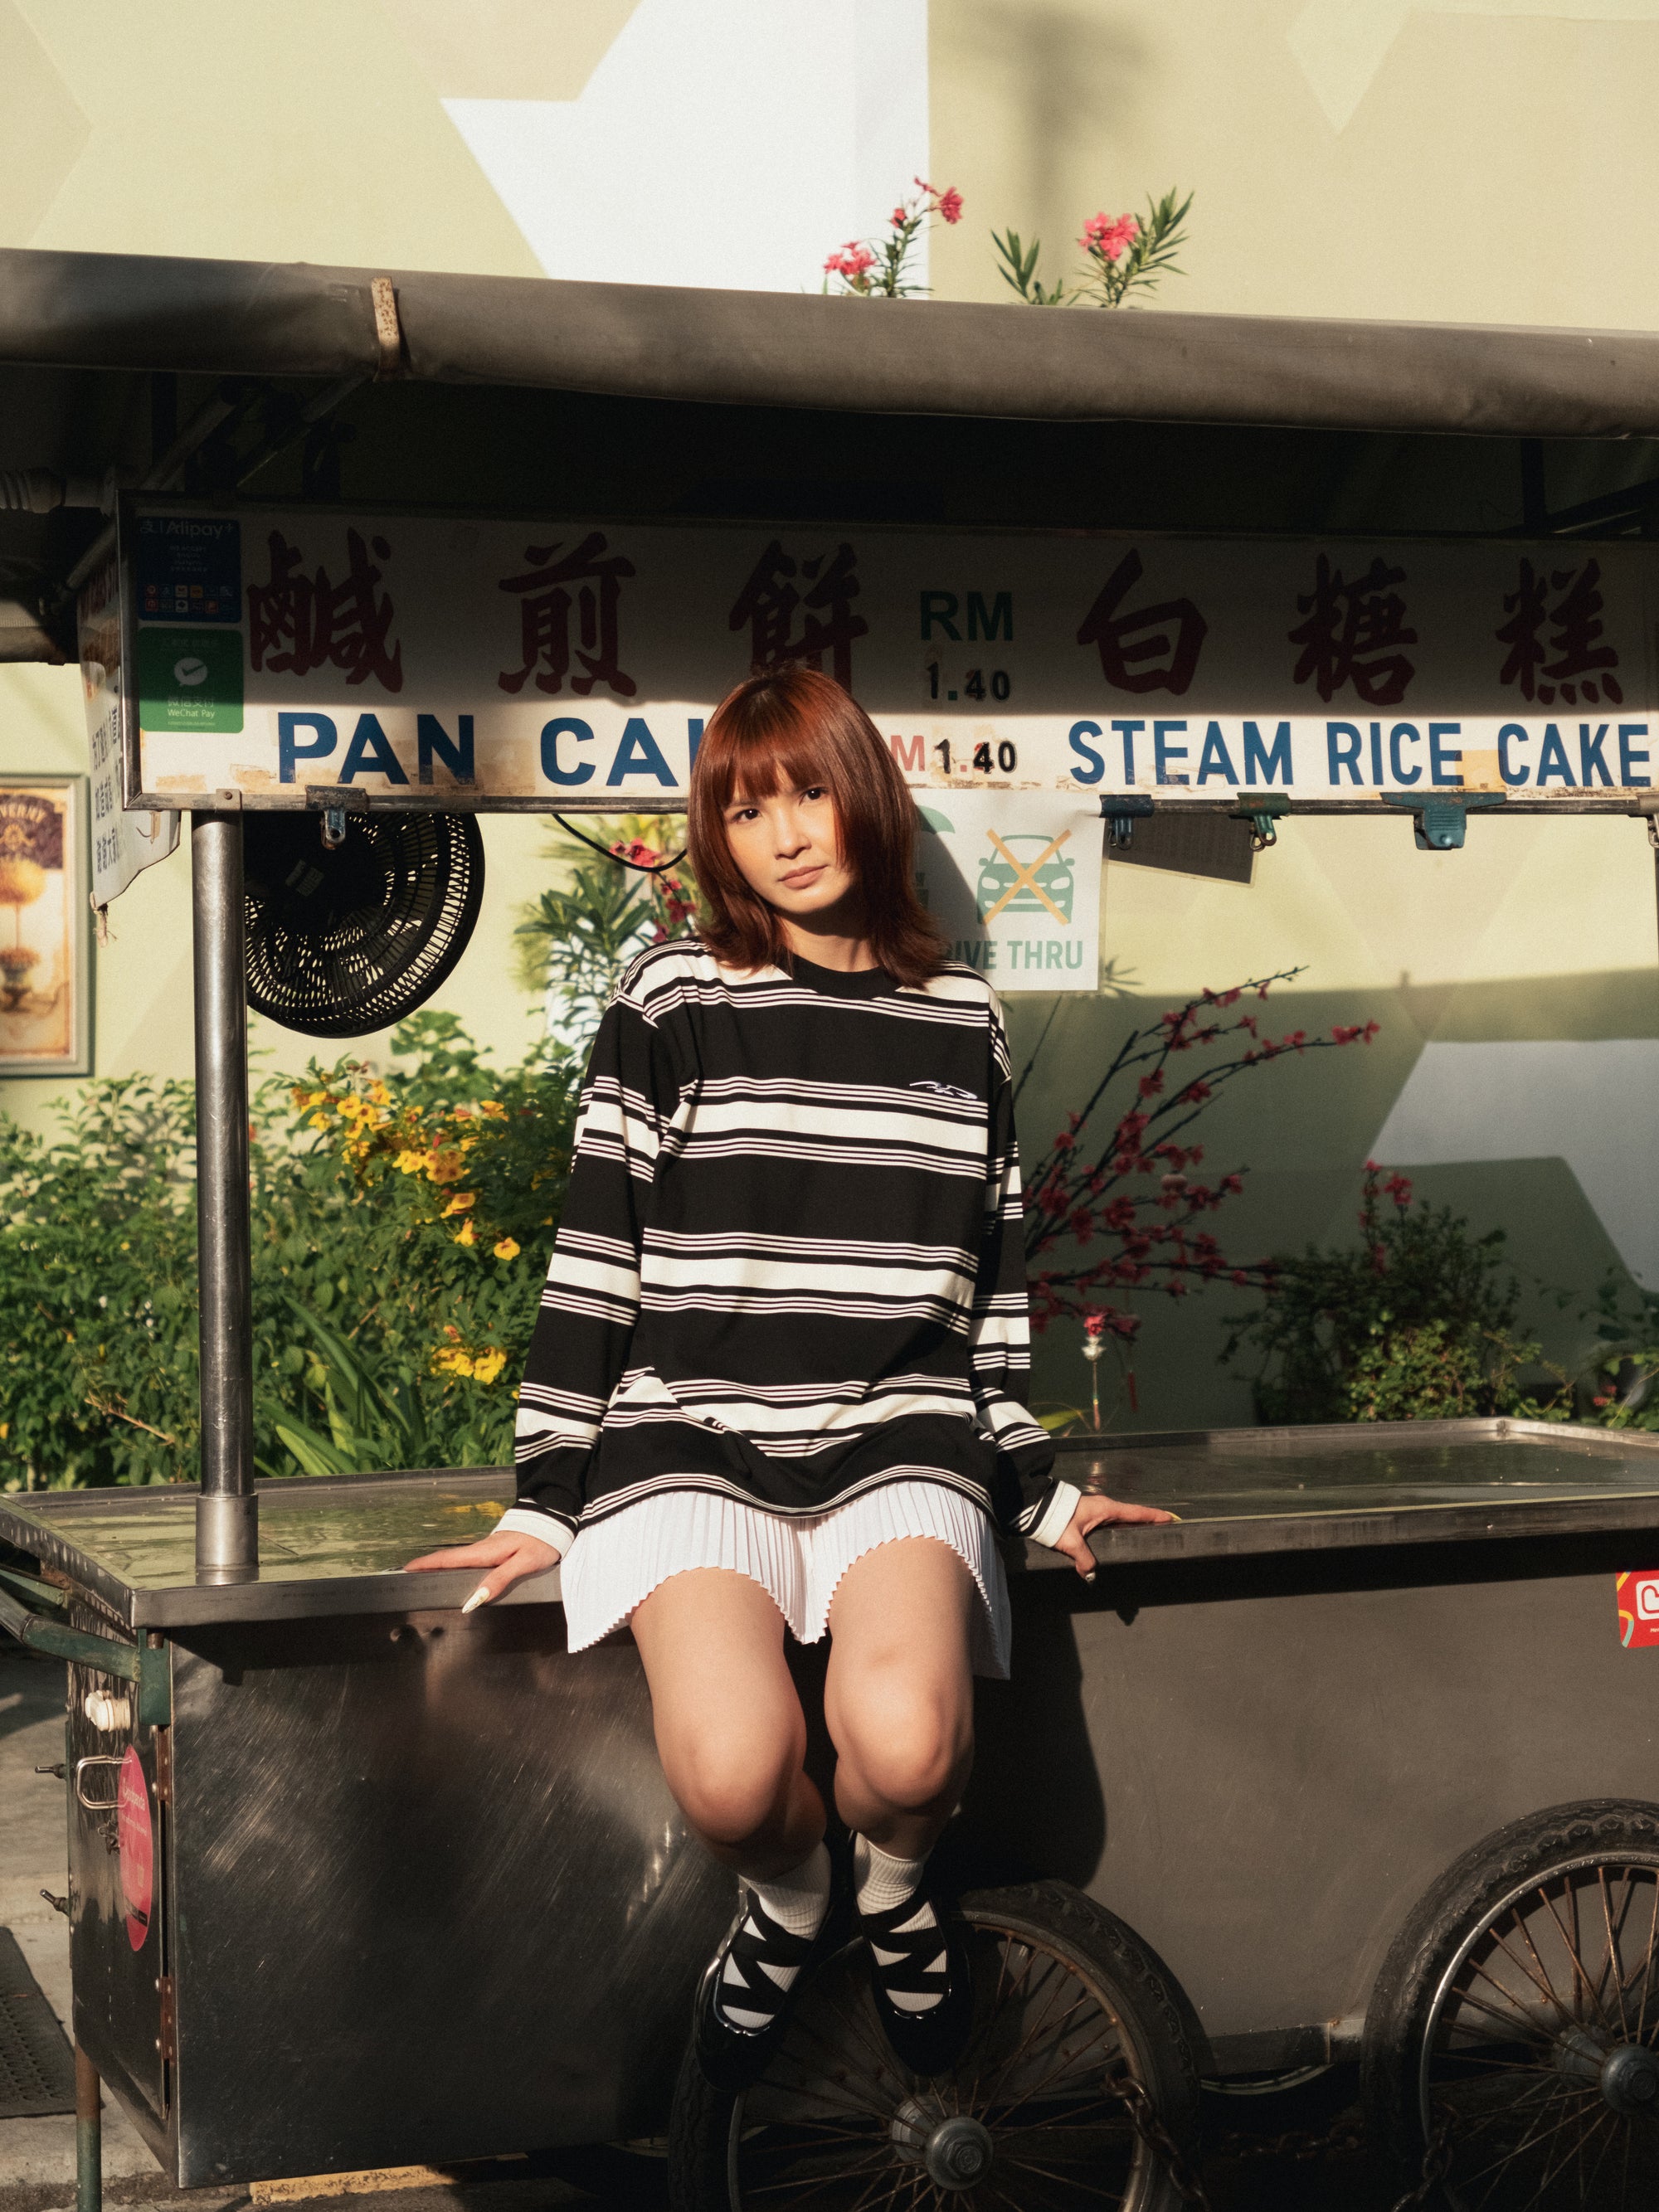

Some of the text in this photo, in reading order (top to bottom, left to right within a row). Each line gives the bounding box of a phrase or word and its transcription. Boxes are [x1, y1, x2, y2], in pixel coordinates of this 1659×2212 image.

[919, 591, 1014, 641] RM
[1078, 547, 1623, 706] 白糖糕
[926, 661, 1012, 701] 1.40
[168, 709, 215, 719] WeChat Pay
[277, 712, 703, 786] PAN CA
[890, 735, 1018, 775] M 1.40
[1068, 720, 1652, 788] STEAM RICE CAKE
[950, 940, 1083, 970] IVE THRU
